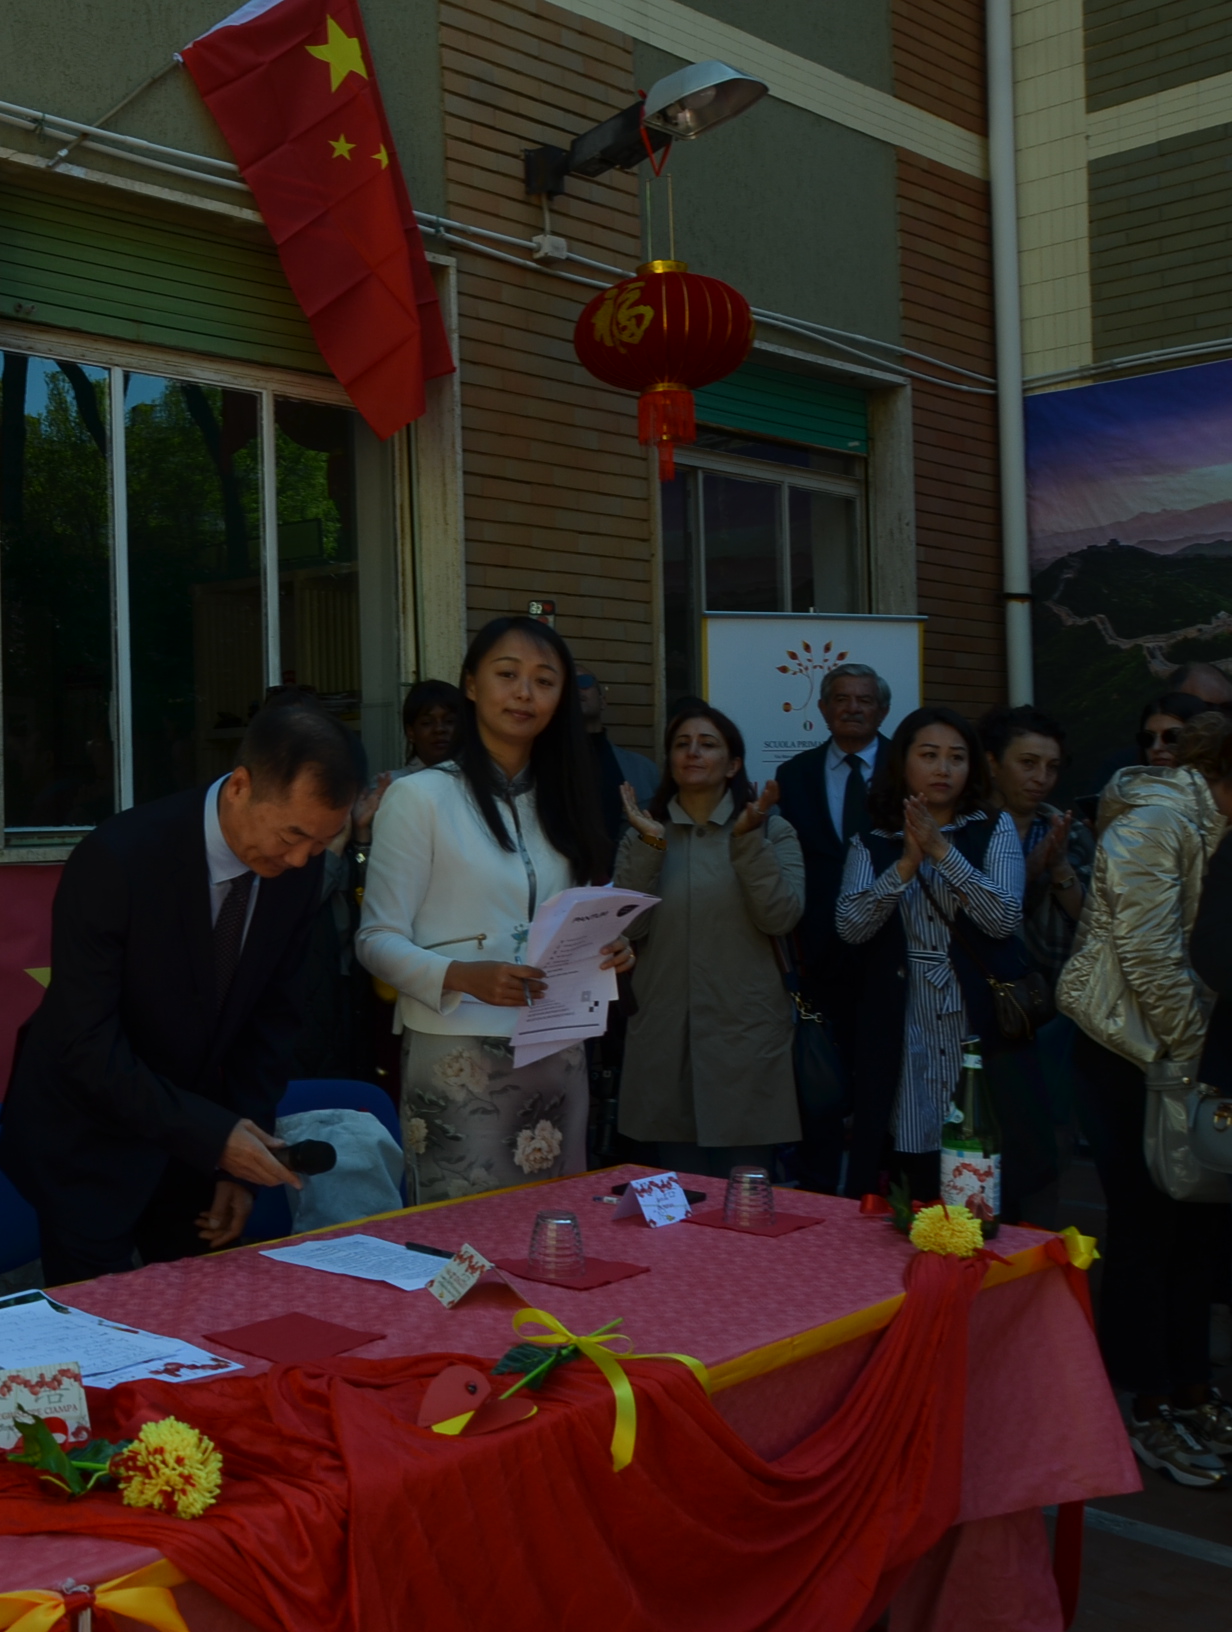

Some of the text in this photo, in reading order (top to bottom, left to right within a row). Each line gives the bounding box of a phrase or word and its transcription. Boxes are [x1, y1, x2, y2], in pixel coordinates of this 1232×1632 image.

[591, 281, 655, 354] 福
[763, 740, 796, 749] SCUOLA
[44, 1403, 78, 1415] CIAMPA
